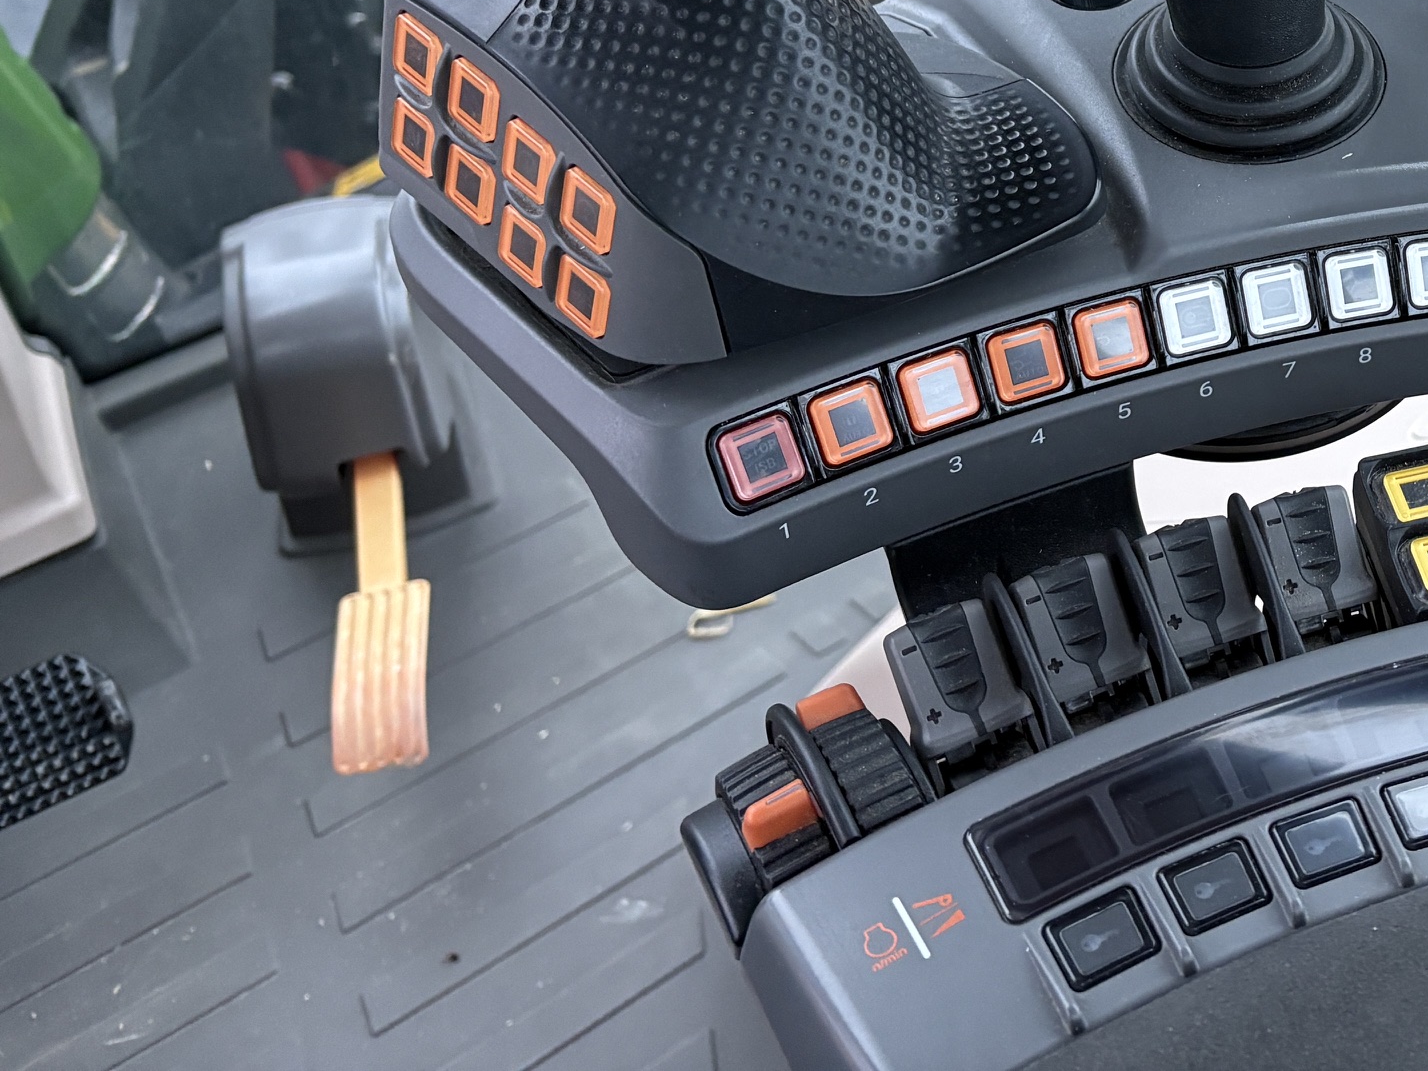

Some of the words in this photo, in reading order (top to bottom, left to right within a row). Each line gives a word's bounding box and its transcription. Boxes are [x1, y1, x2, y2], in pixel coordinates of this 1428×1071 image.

[778, 522, 790, 539] 1
[863, 487, 880, 507] 2
[948, 455, 963, 473] 3
[1030, 427, 1046, 444] 4
[1118, 401, 1132, 420] 5
[1199, 380, 1213, 398] 6
[1282, 360, 1297, 379] 7
[1358, 347, 1372, 364] 8
[872, 947, 908, 972] n/min
